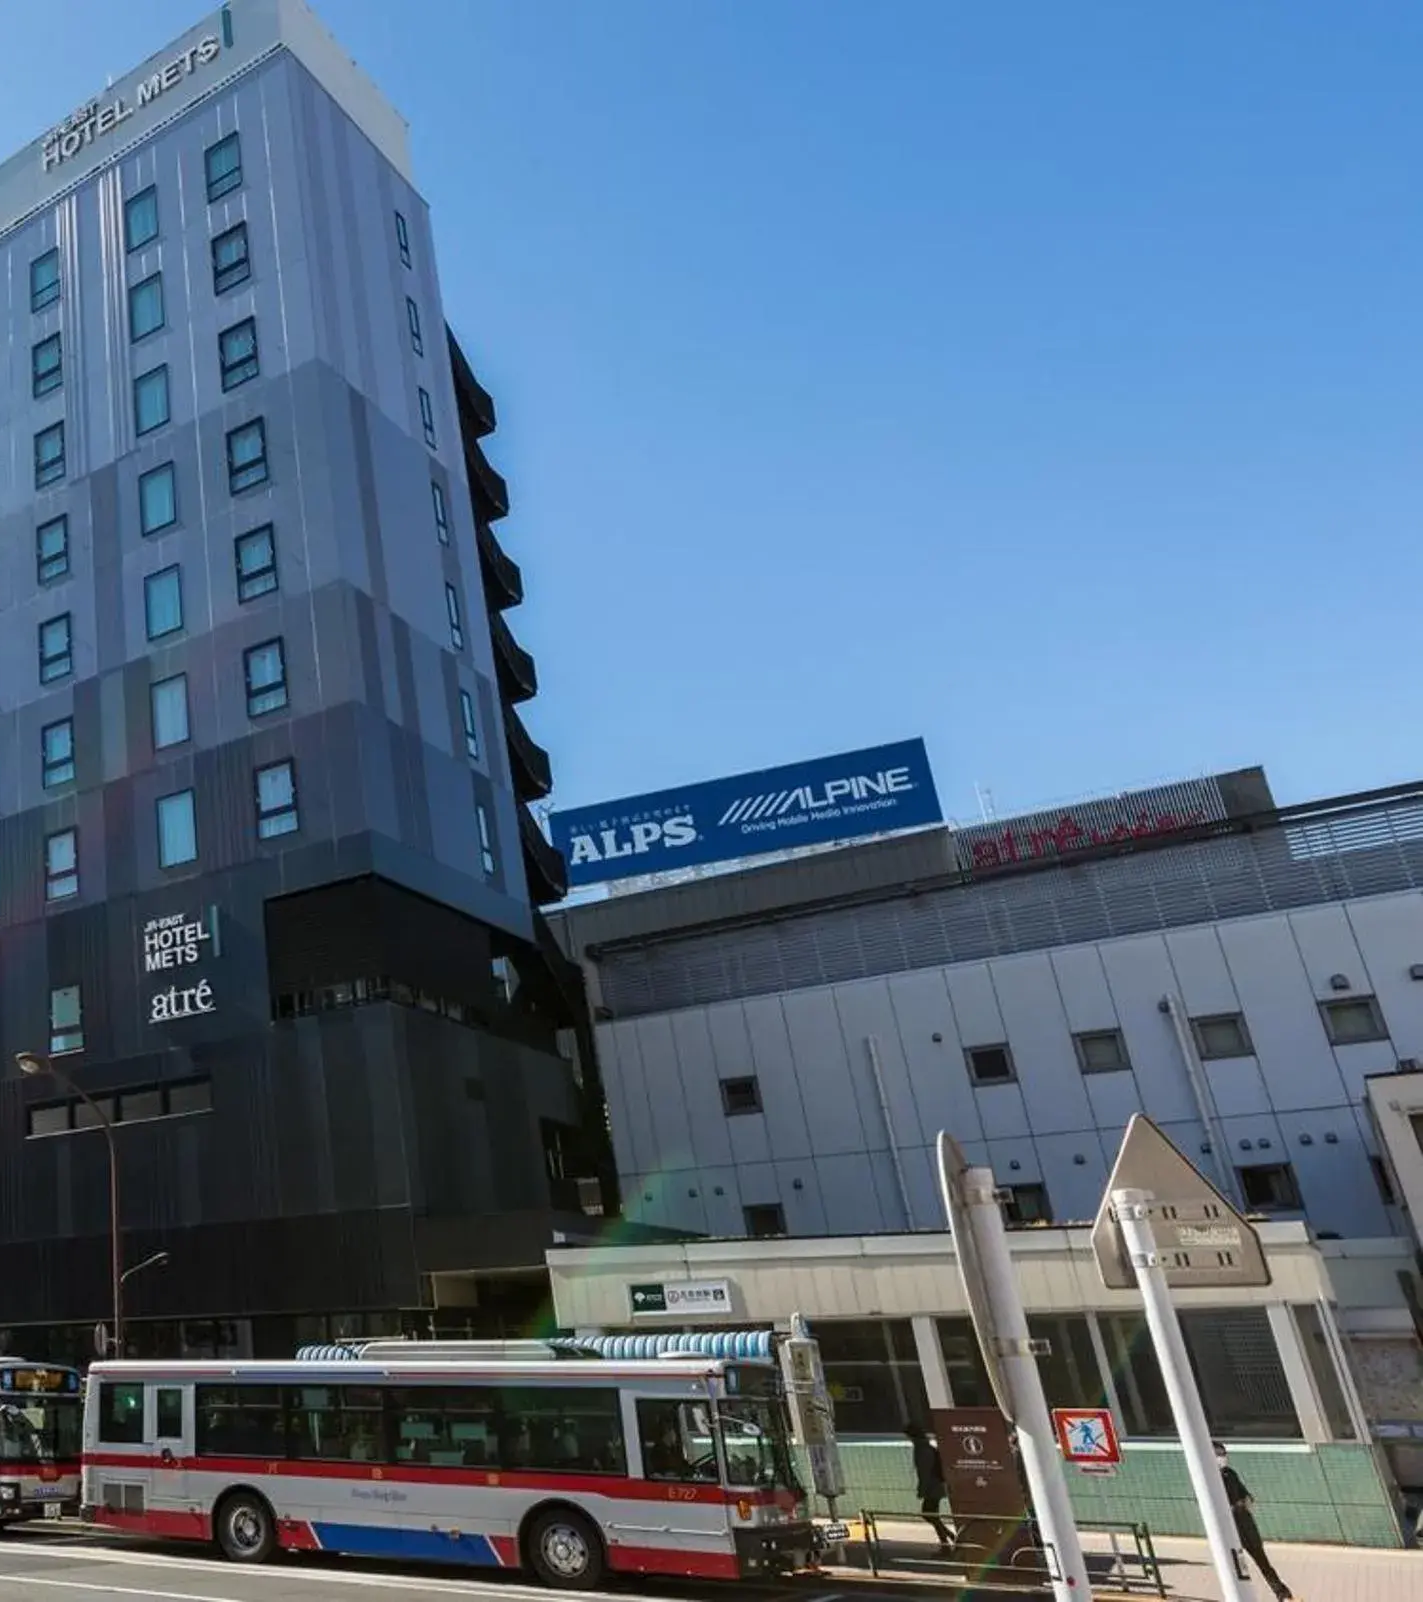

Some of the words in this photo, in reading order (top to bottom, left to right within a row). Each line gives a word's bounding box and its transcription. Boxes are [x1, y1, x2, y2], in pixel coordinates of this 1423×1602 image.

[42, 99, 134, 173] HOTEL
[137, 35, 221, 108] METS
[777, 766, 914, 816] ALPINE
[741, 820, 777, 835] Driving
[777, 813, 810, 828] Mobile
[810, 807, 842, 821] Media
[841, 797, 898, 815] Innovation
[569, 813, 697, 866] ALPS
[144, 921, 211, 953] HOTEL
[145, 942, 198, 972] METS
[149, 978, 217, 1024] atré
